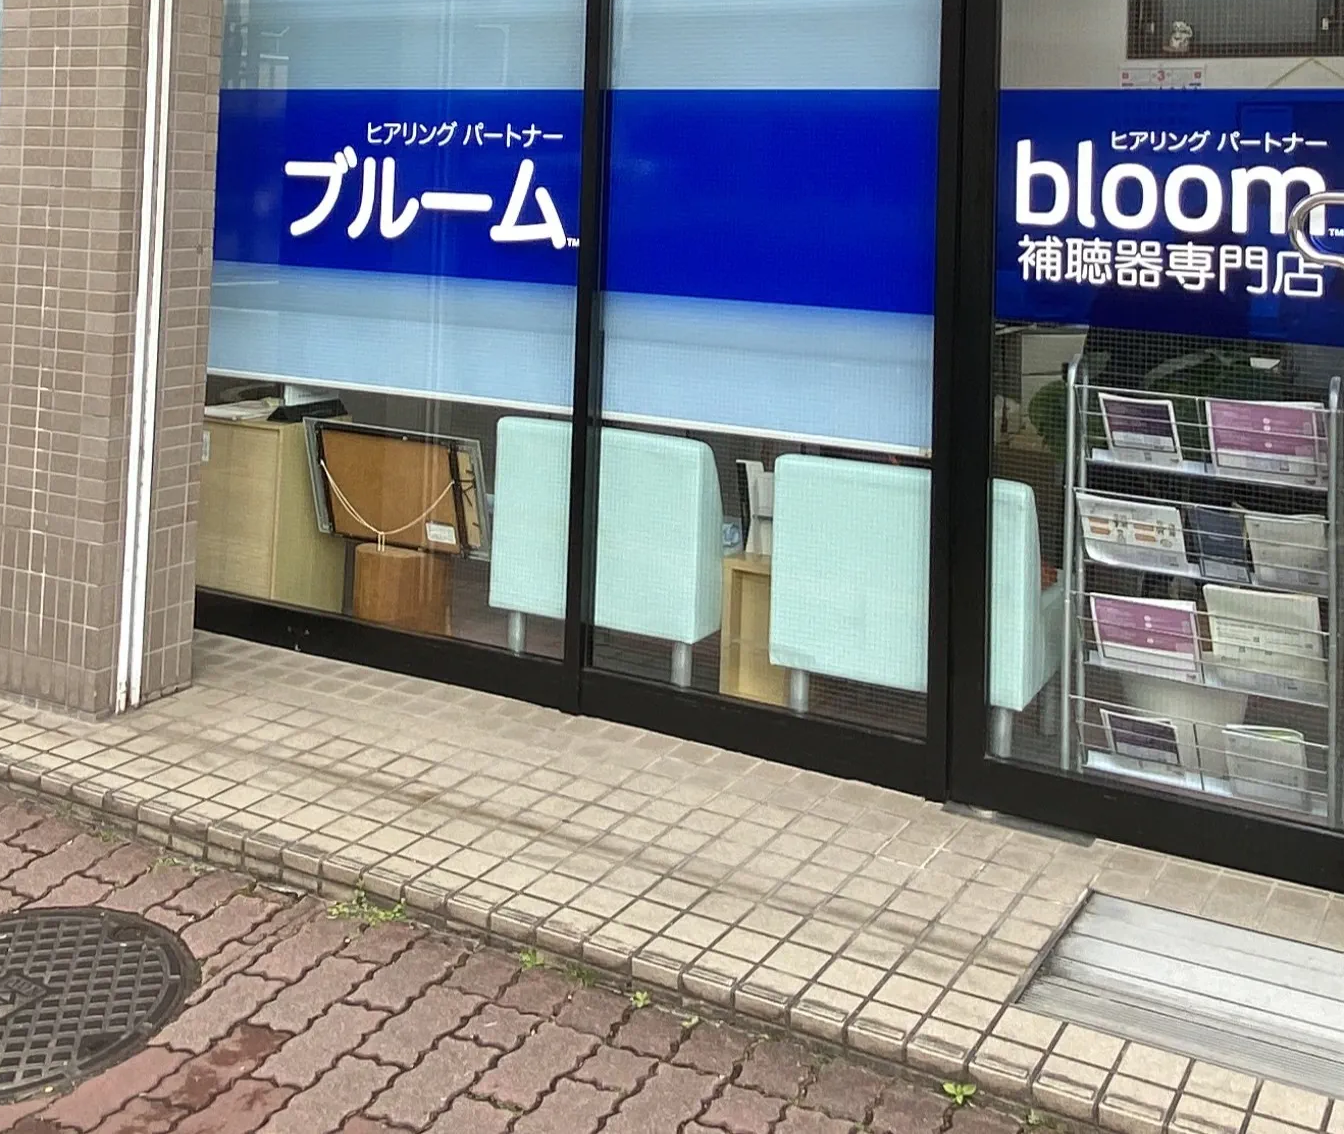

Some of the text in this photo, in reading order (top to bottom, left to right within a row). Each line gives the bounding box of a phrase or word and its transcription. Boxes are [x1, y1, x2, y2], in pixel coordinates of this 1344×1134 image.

[366, 121, 564, 148] ヒアリング パートナー
[1110, 130, 1328, 153] ヒアリング パートナー
[284, 145, 567, 250] ブルーム
[1015, 138, 1327, 236] bloom
[1017, 234, 1325, 298] 補聴器専門店
